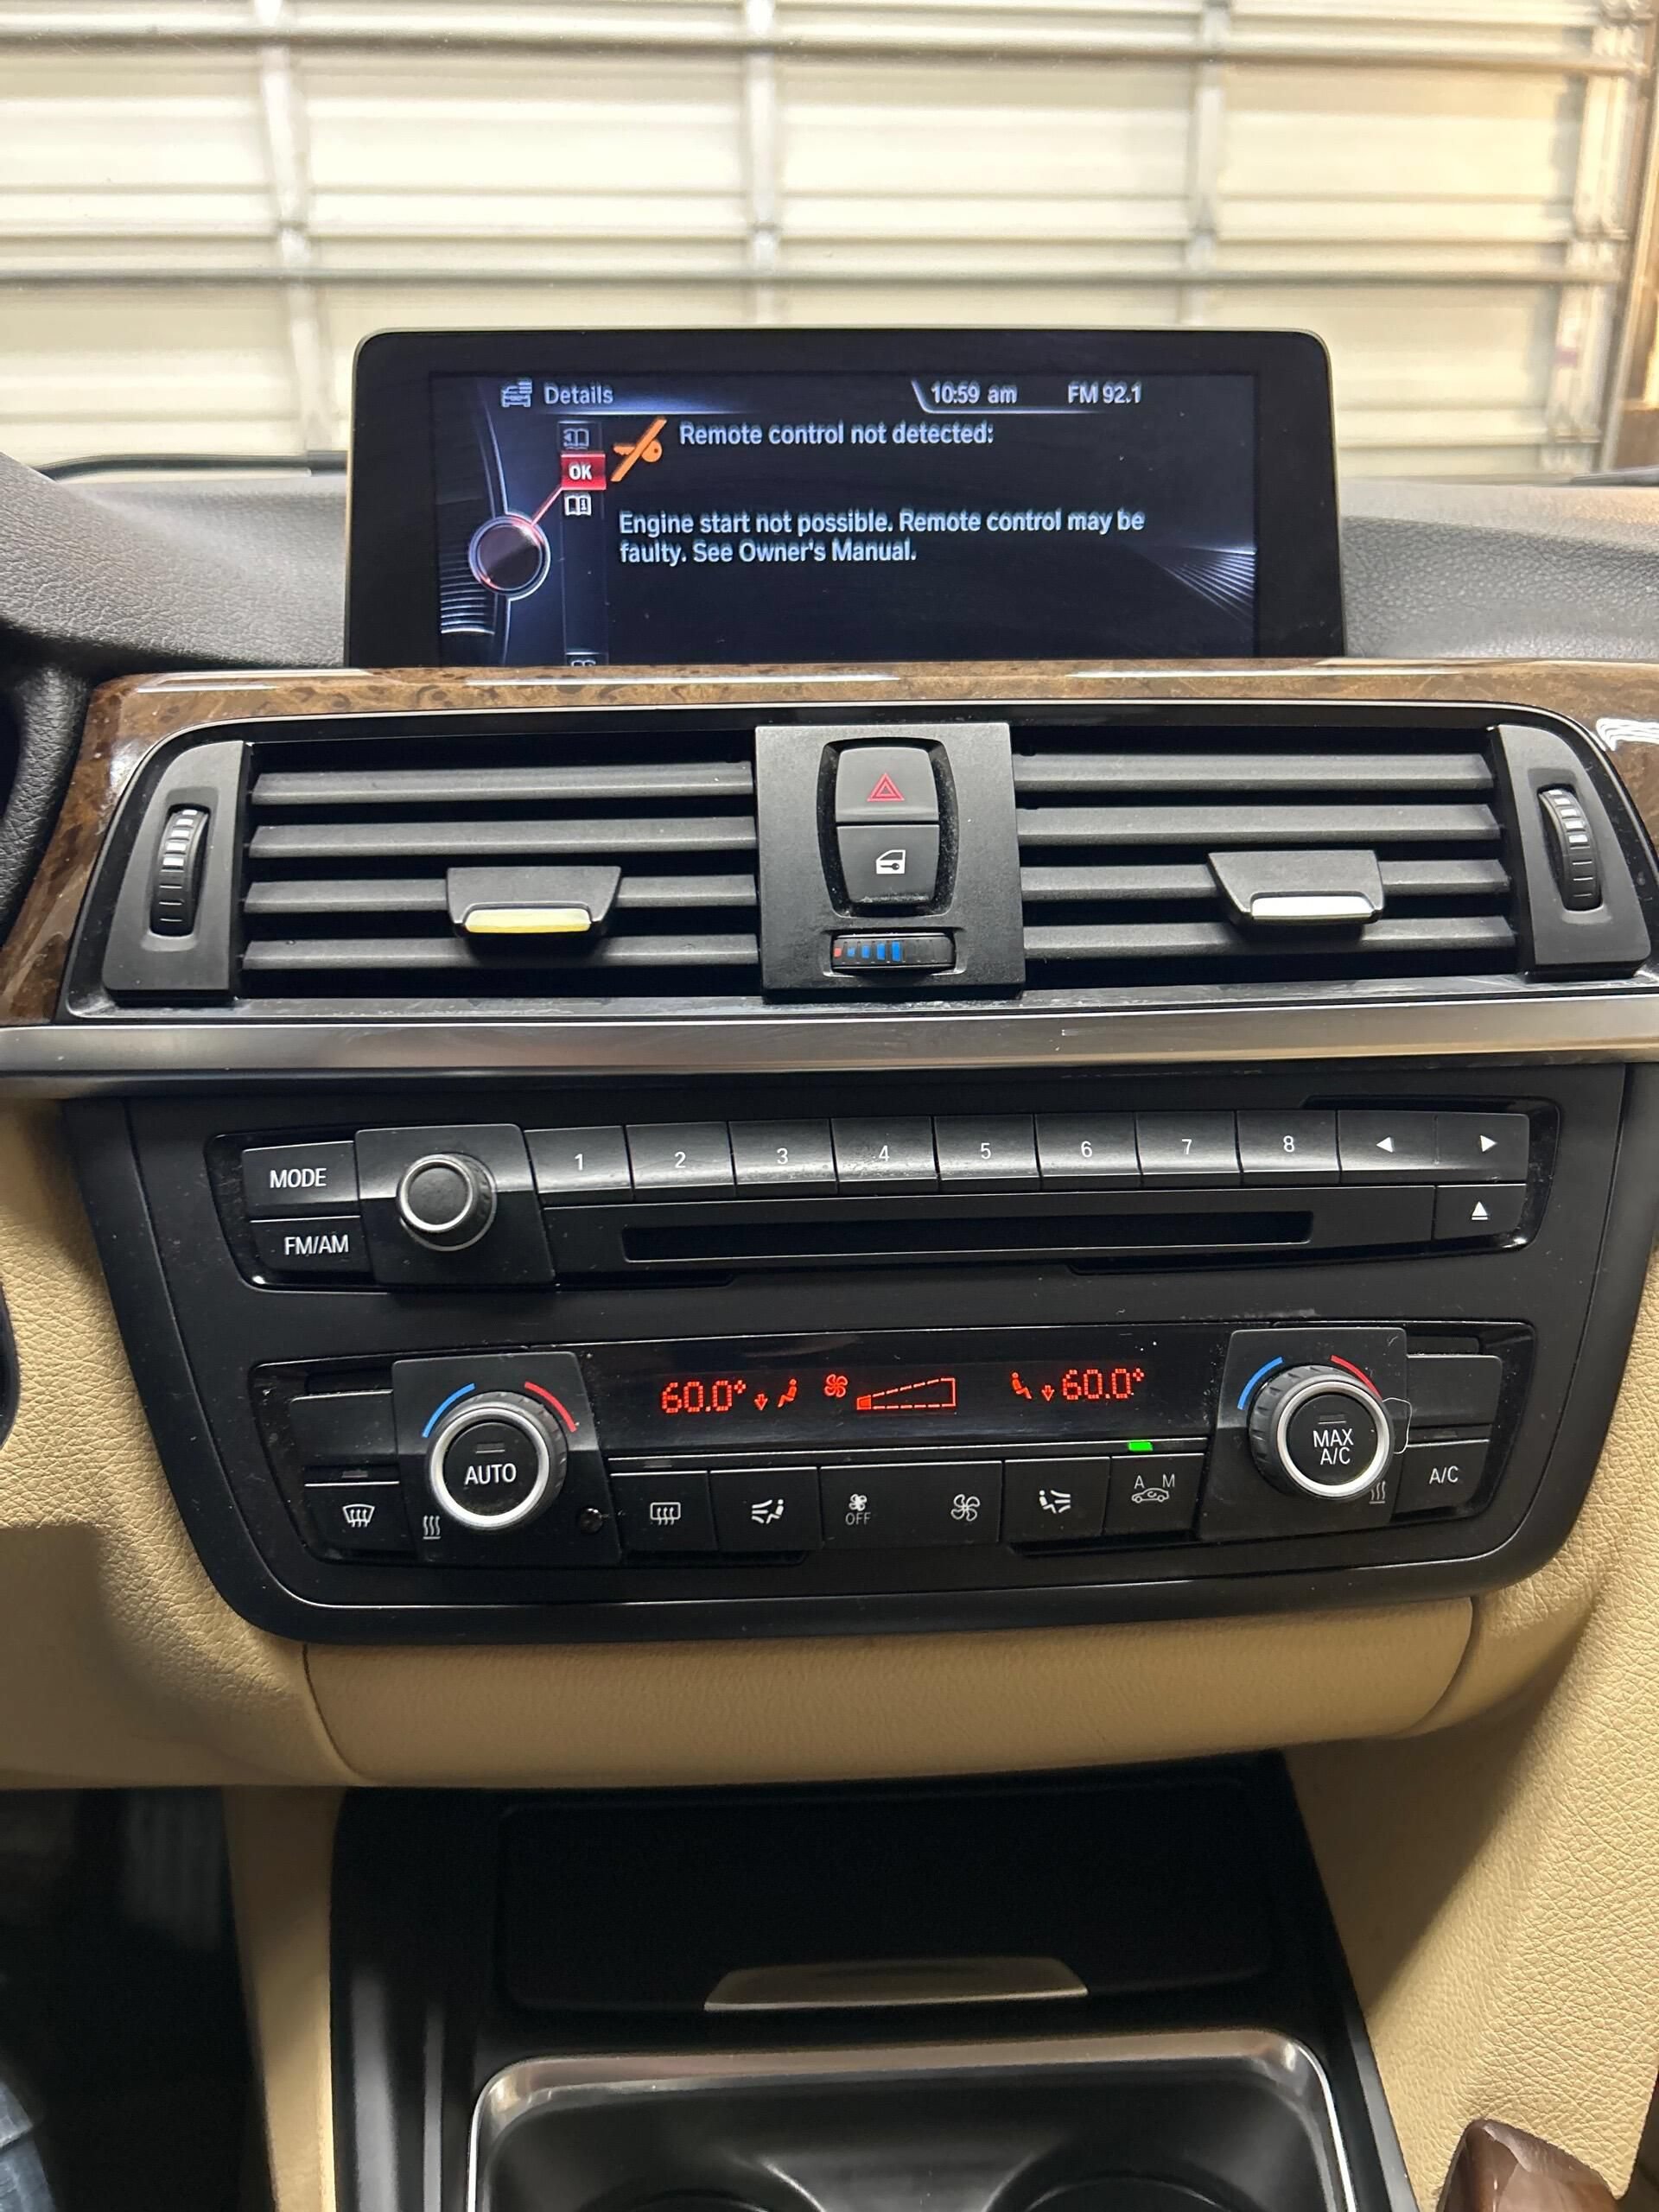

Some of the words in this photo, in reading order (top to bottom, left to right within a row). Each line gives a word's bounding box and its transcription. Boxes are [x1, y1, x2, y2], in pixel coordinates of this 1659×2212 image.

[543, 383, 613, 405] Details
[931, 380, 981, 404] 10:59
[987, 385, 1018, 404] am
[1067, 380, 1099, 404] FM
[1102, 379, 1143, 404] 92.1
[679, 421, 762, 445] Remote
[768, 419, 844, 445] control
[850, 422, 887, 445] not
[892, 418, 995, 444] detected:
[569, 463, 592, 480] OK
[619, 511, 694, 538] Engine
[700, 511, 750, 534] start
[756, 510, 792, 533] not
[797, 507, 893, 537] possible.
[899, 507, 982, 532] Remote
[986, 507, 1062, 532] control
[1067, 511, 1113, 536] may
[1116, 507, 1145, 531] be
[620, 539, 687, 567] faulty.
[692, 538, 734, 563] See
[739, 537, 826, 563] Owner's
[831, 536, 917, 562] Manual.
[878, 1145, 890, 1162] 4
[980, 1142, 992, 1160] 5
[1080, 1141, 1092, 1159] 6
[1181, 1138, 1193, 1155] 7
[1283, 1135, 1295, 1154] 8
[575, 1154, 584, 1170] 1
[674, 1151, 687, 1169] 2
[776, 1147, 789, 1166] 3
[269, 1167, 327, 1189] MODE
[284, 1234, 349, 1257] FM/AM
[1313, 1427, 1354, 1448] MAX
[1319, 1446, 1351, 1465] A/C
[463, 1463, 518, 1487] AUTO
[1134, 1474, 1146, 1490] A
[1162, 1472, 1175, 1488] M
[1429, 1465, 1459, 1485] A/C
[845, 1511, 871, 1526] OFF
